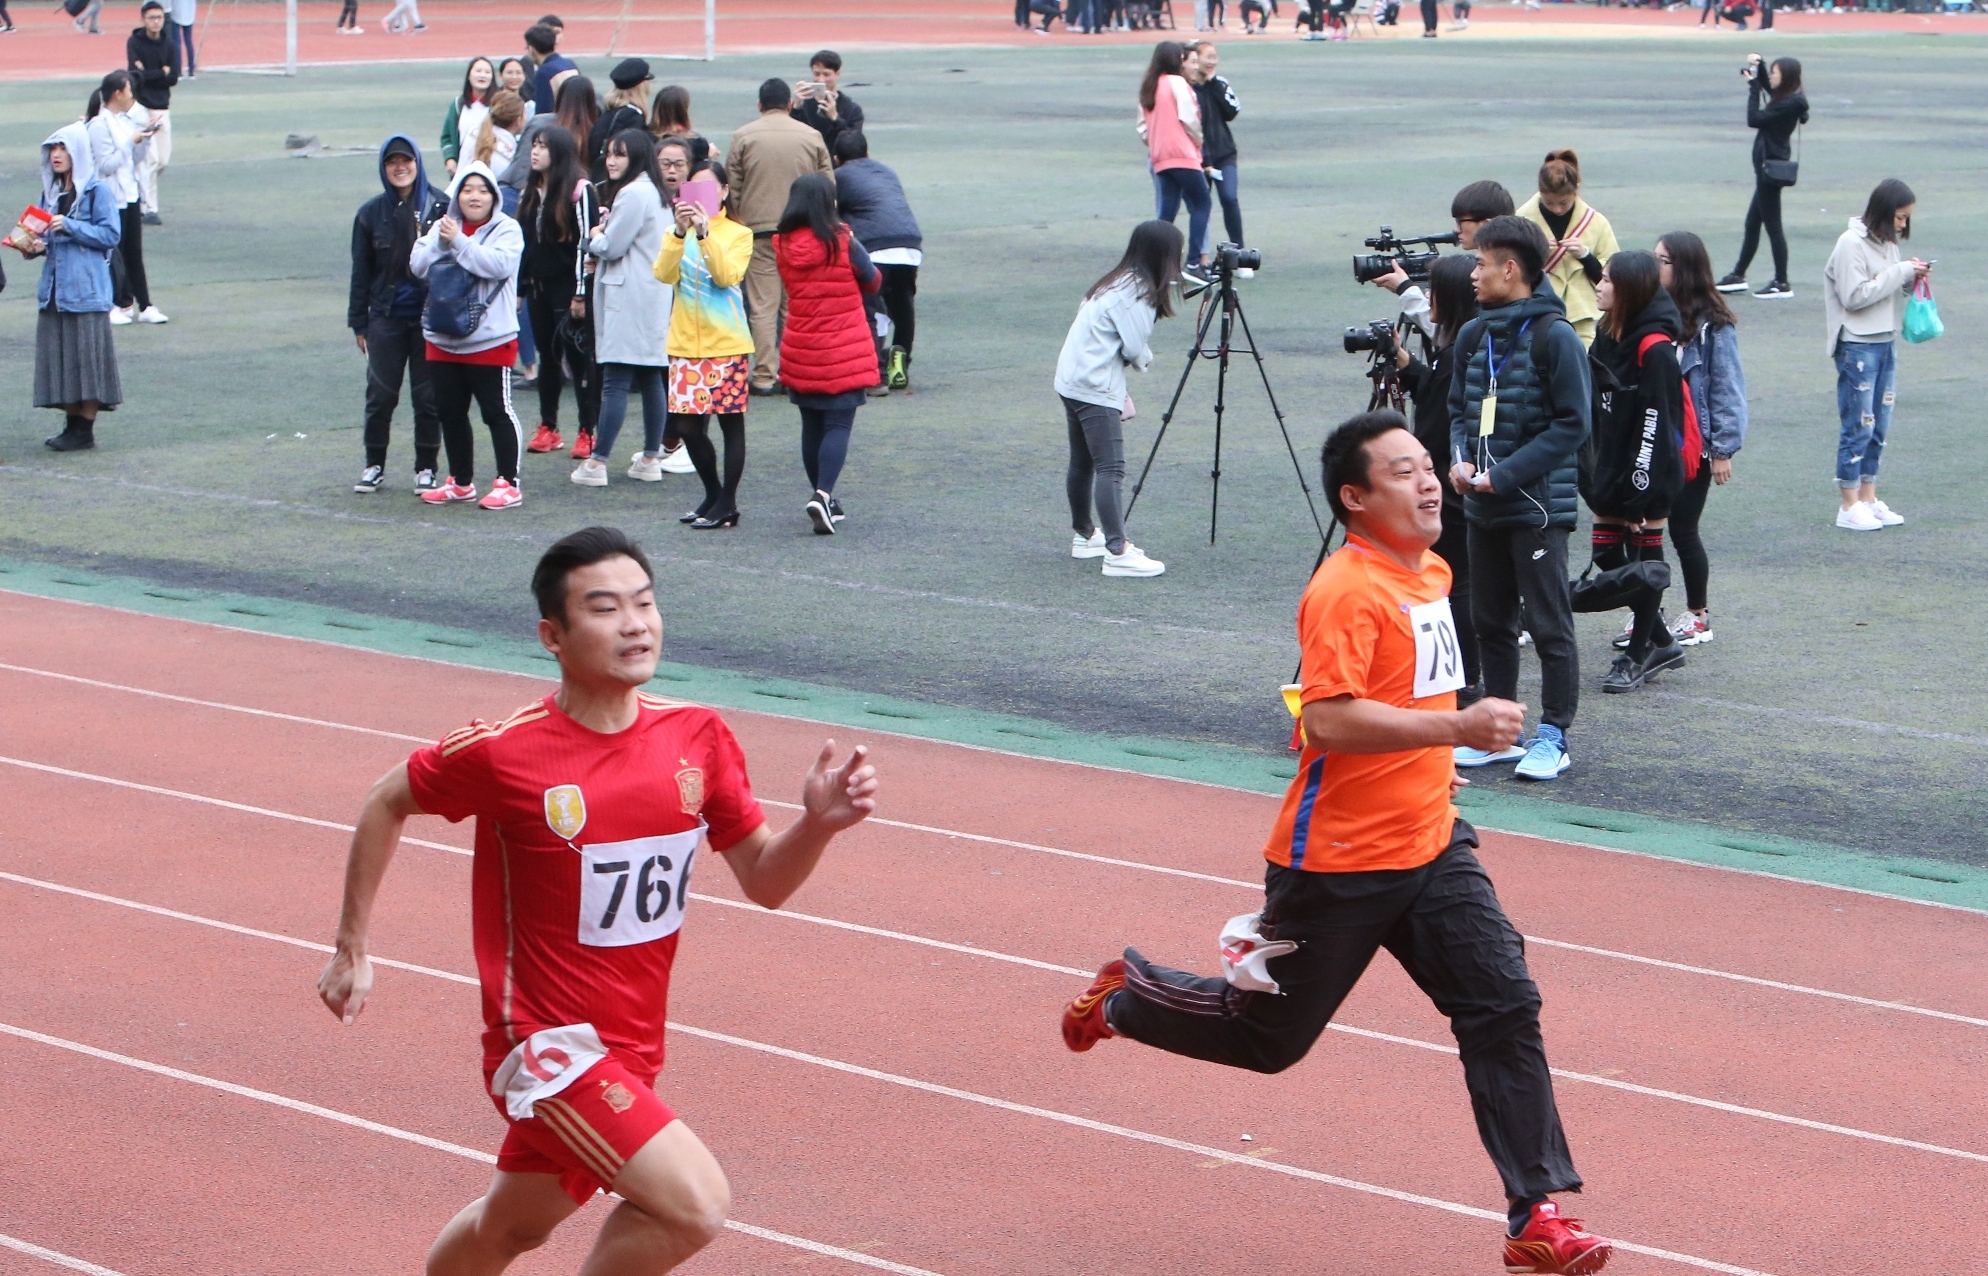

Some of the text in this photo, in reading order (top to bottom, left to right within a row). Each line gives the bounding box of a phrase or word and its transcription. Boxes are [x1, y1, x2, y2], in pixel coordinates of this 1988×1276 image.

[1635, 408, 1659, 471] SAINT PABLO
[1420, 620, 1457, 681] 79
